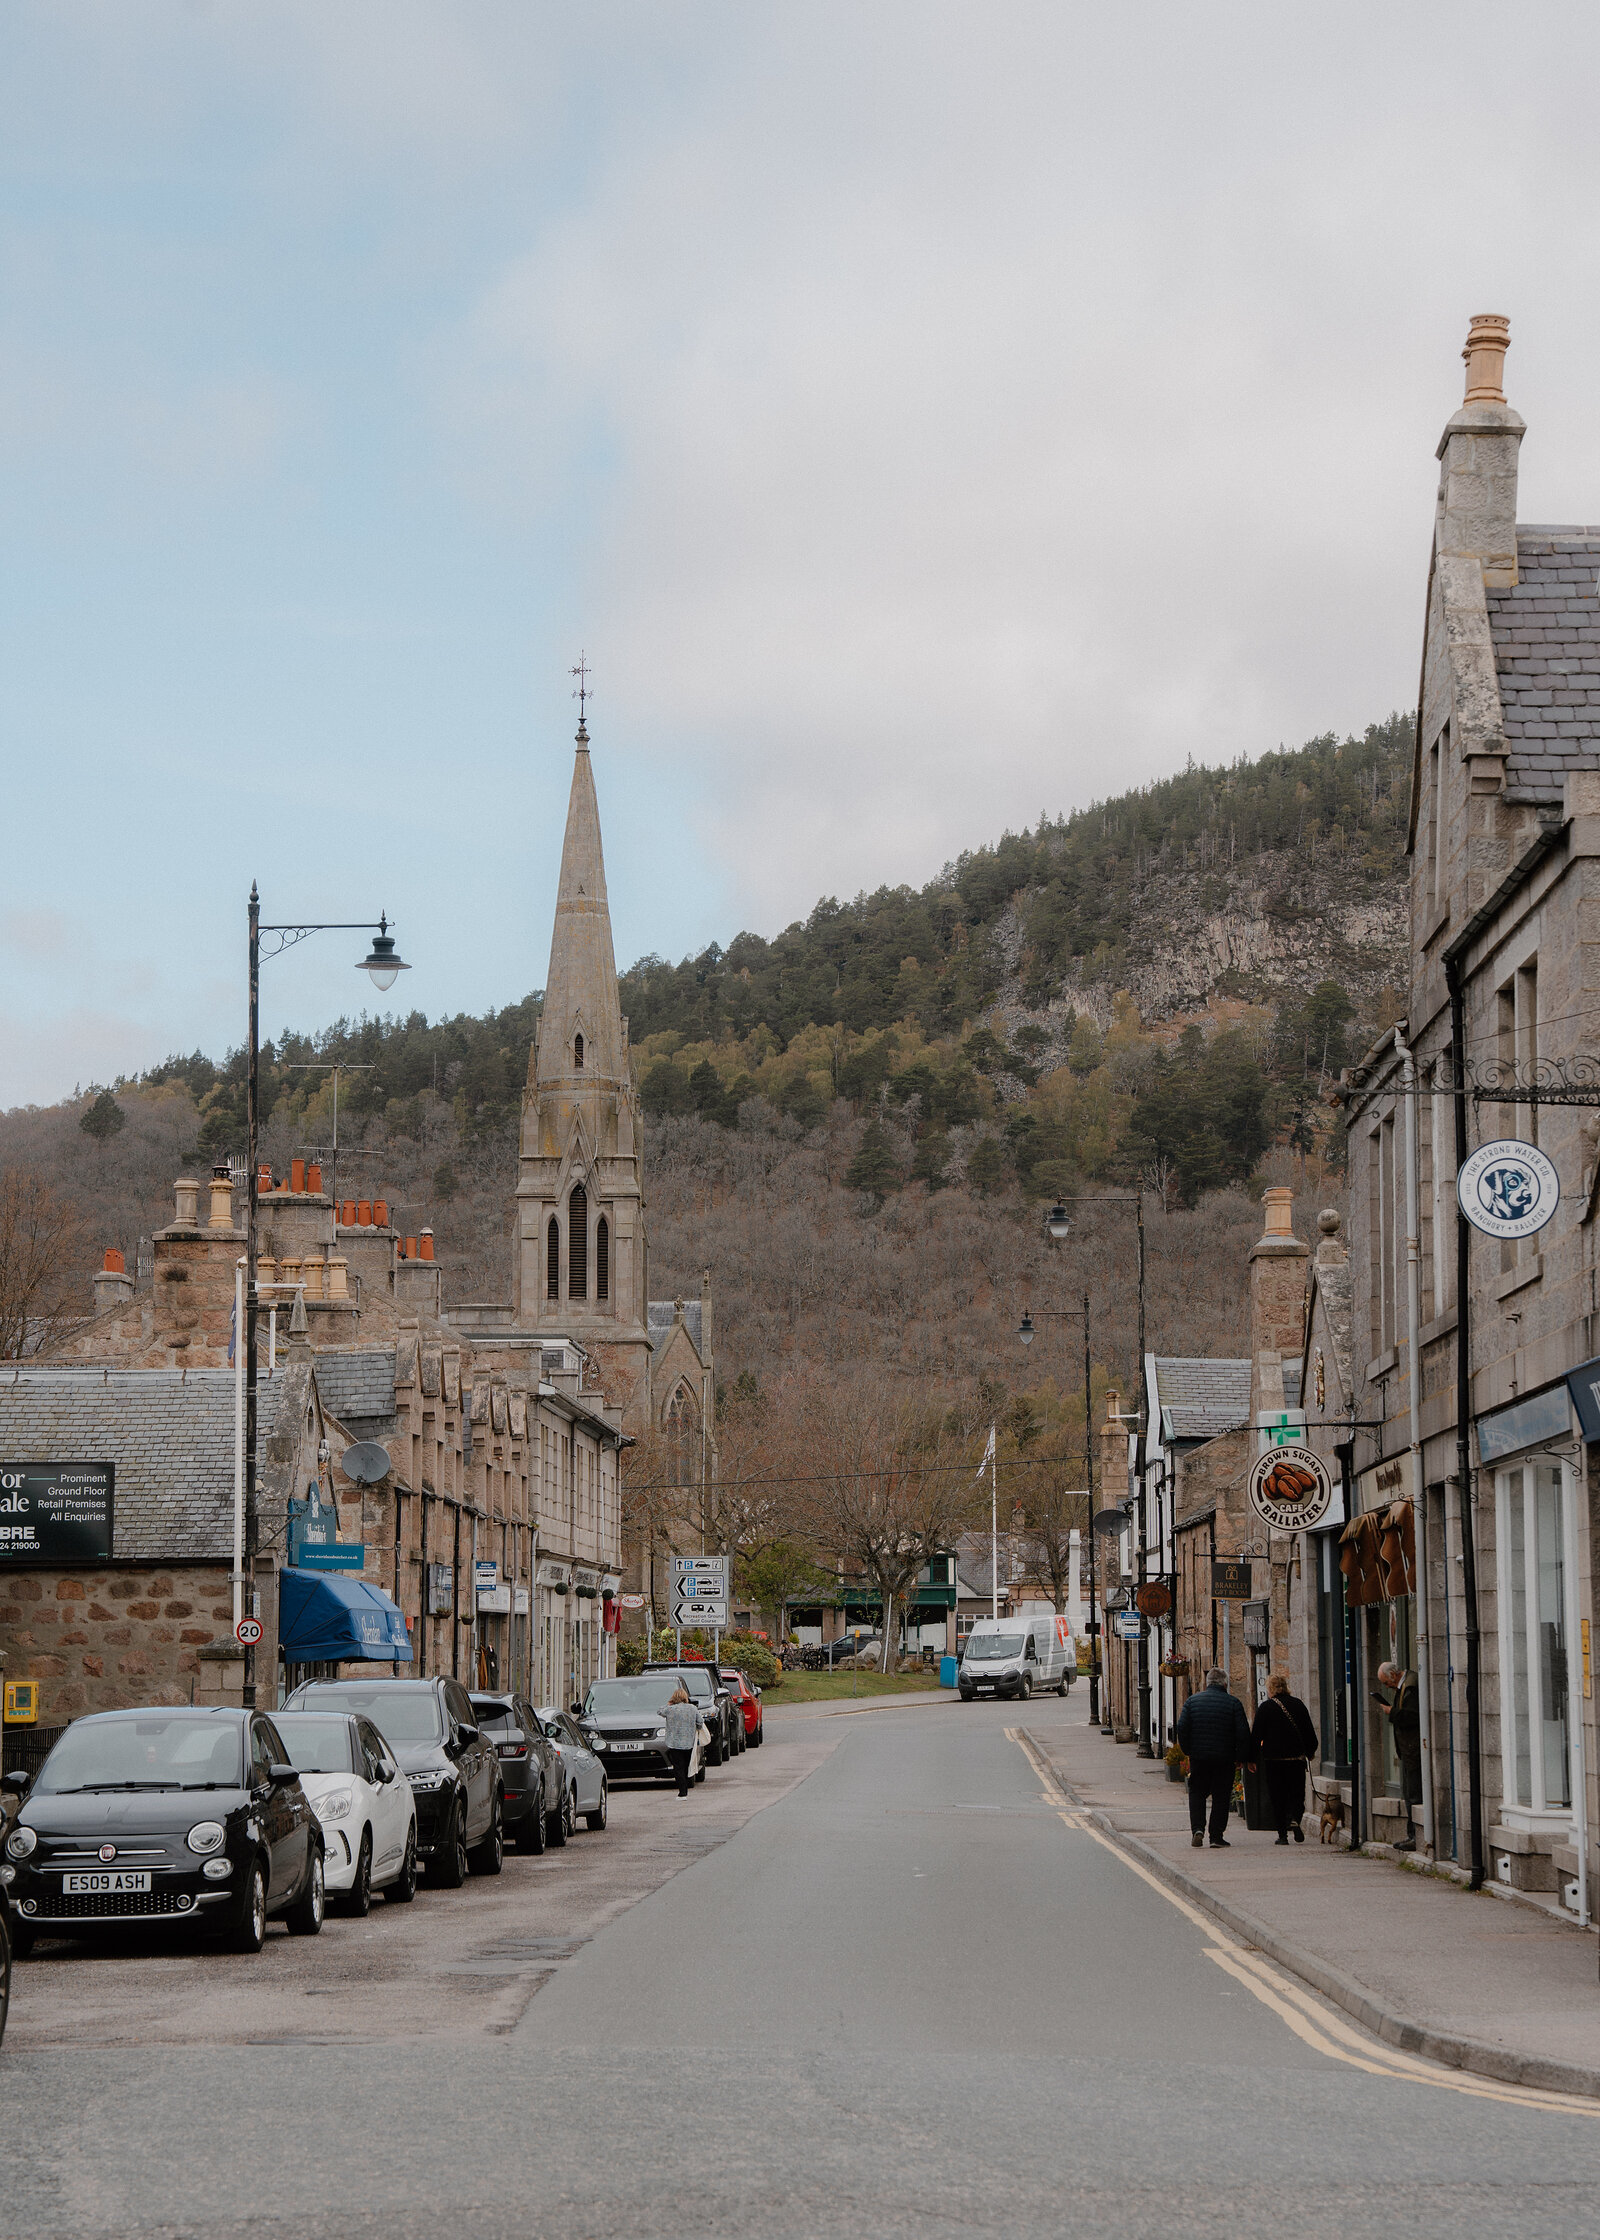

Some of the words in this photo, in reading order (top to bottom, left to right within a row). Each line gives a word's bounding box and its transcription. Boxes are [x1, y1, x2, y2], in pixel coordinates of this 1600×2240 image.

[1467, 1161, 1481, 1177] THE
[1479, 1145, 1511, 1163] STRONG
[1514, 1146, 1542, 1166] WATER
[1470, 1206, 1505, 1232] BANCHORY
[1514, 1207, 1548, 1232] BALLATER
[1259, 1449, 1289, 1475] BROWN
[1292, 1450, 1321, 1475] SUGAR
[0, 1469, 25, 1488] or
[60, 1474, 107, 1483] Prominent
[47, 1487, 81, 1496] Ground
[83, 1487, 107, 1496] Floor
[0, 1492, 30, 1513] ale
[38, 1500, 63, 1509] Retail
[65, 1500, 107, 1509] Premises
[1279, 1503, 1304, 1513] CAFE
[50, 1512, 62, 1521] All
[64, 1512, 106, 1522] Enquiries
[1261, 1502, 1322, 1527] BALLATER
[11, 1542, 40, 1550] 219000
[240, 1627, 259, 1637] 20
[70, 1876, 110, 1890] ES09
[115, 1875, 145, 1889] ASH
